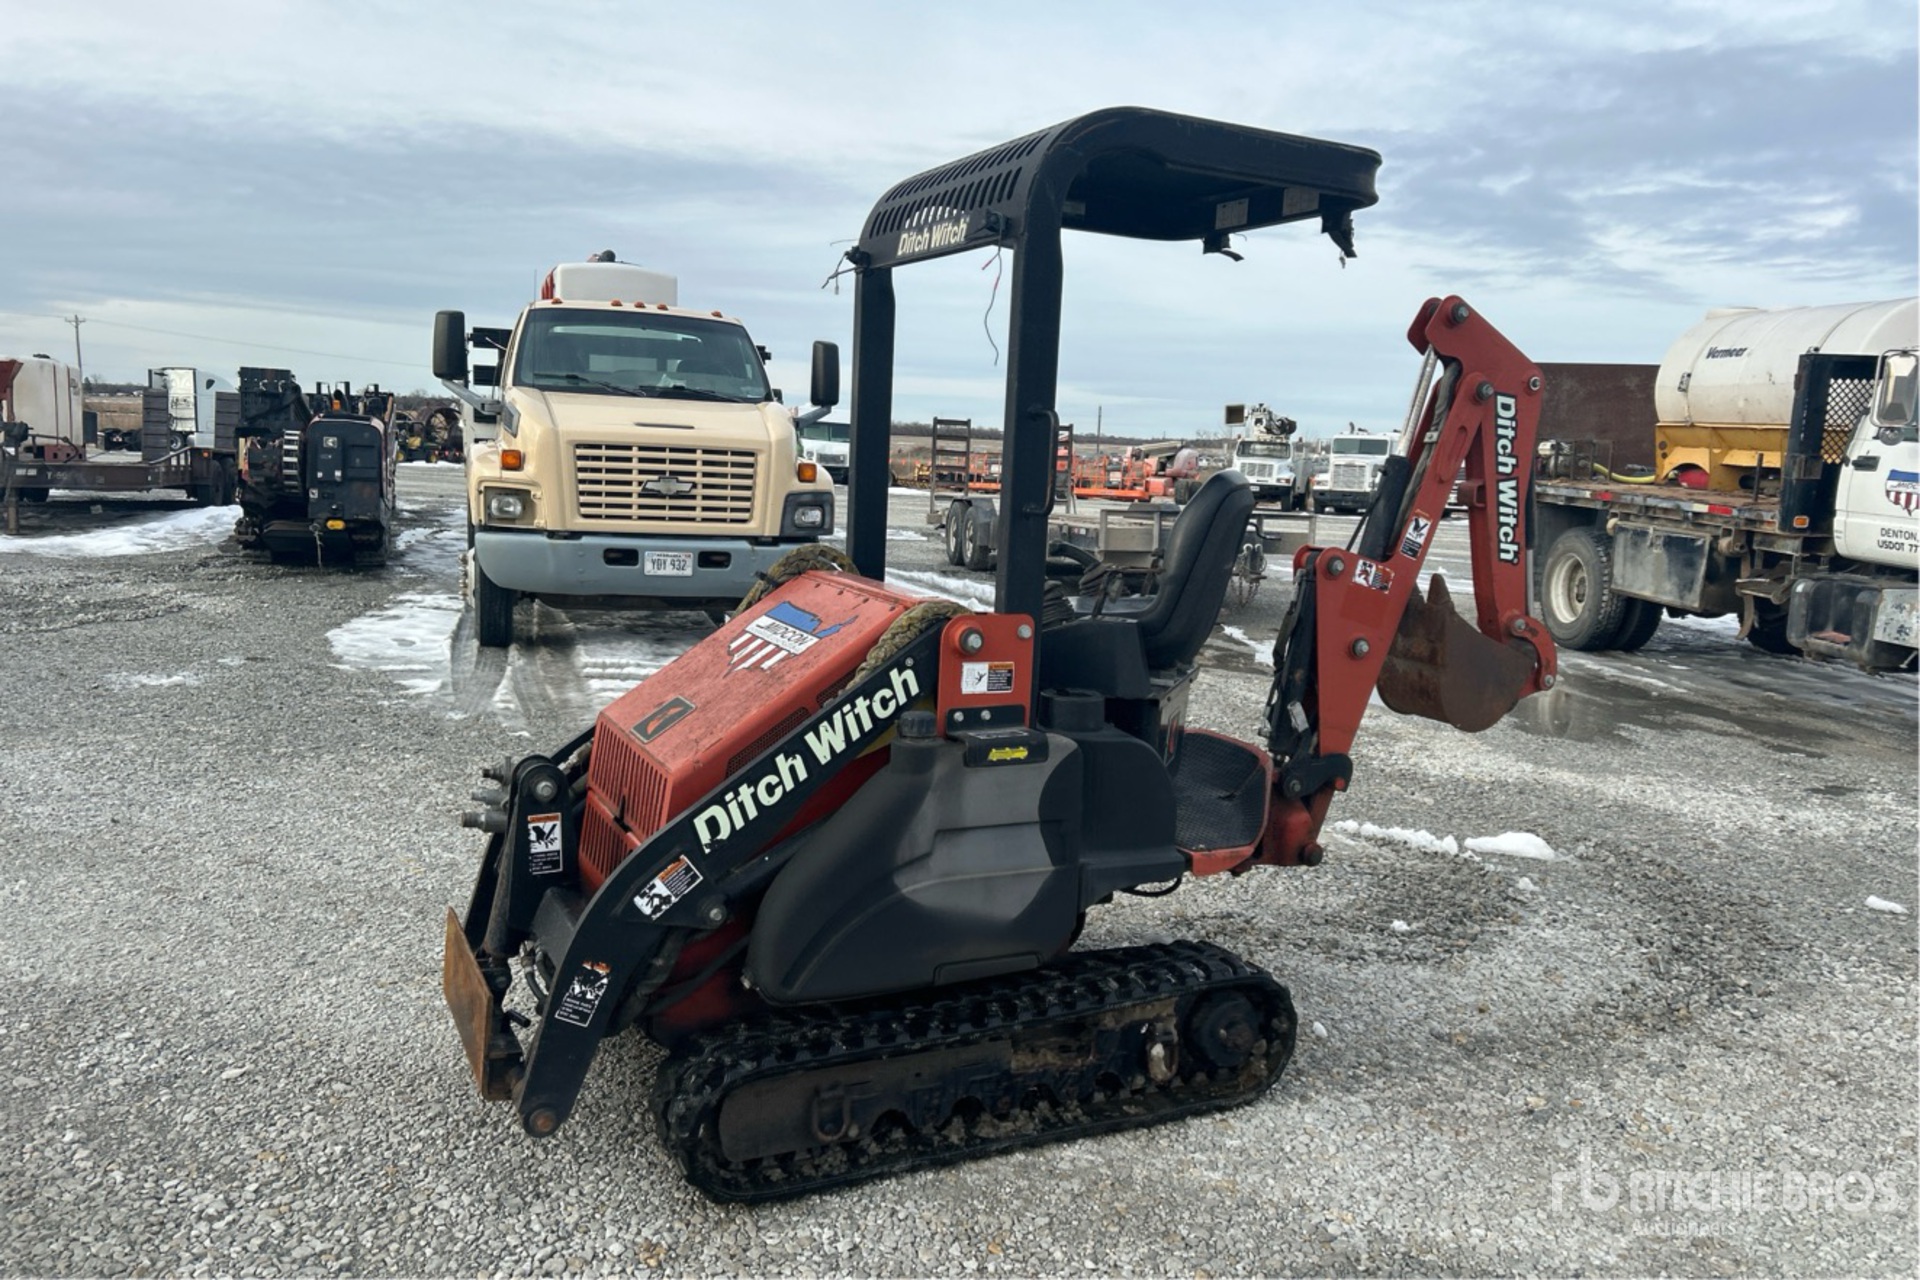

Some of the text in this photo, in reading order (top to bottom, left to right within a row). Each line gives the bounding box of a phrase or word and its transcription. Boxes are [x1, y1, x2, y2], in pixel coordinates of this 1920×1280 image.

[897, 218, 967, 256] Ditch Witch
[1706, 346, 1748, 359] Vermeer
[1496, 395, 1519, 560] Ditch Witch
[693, 667, 920, 855] Ditch Witch
